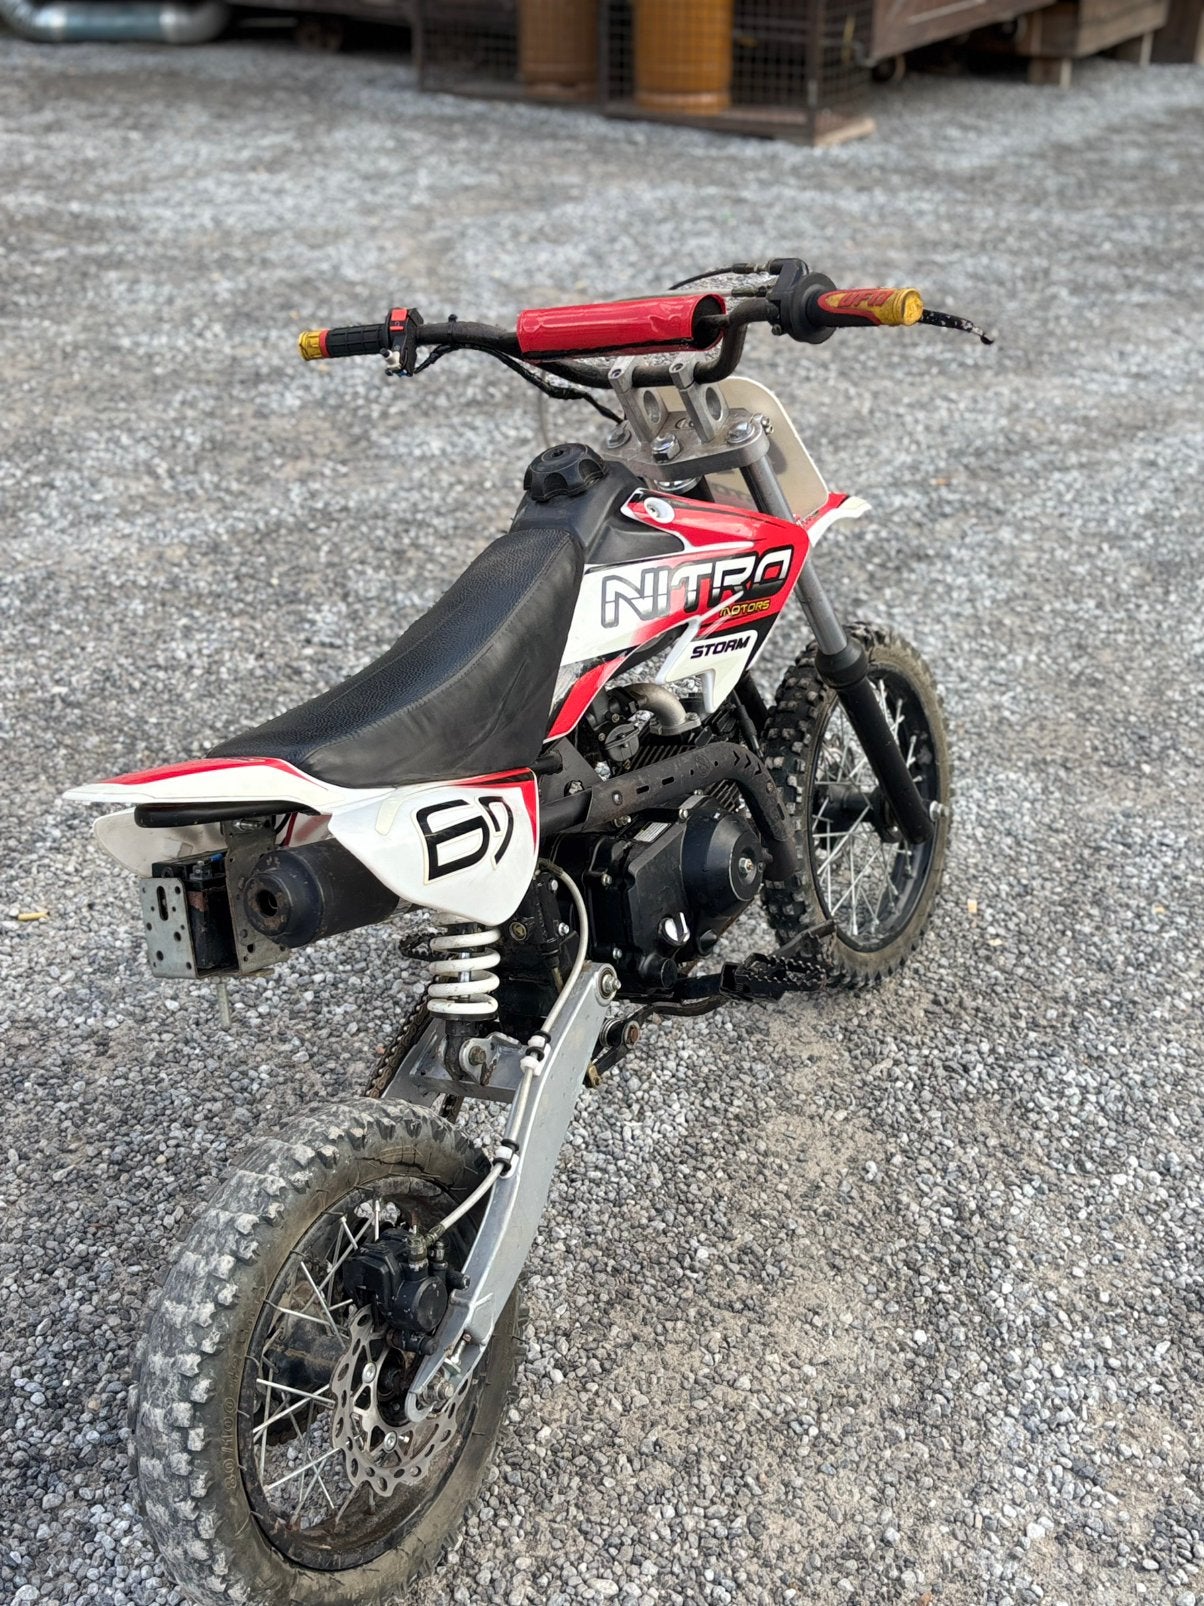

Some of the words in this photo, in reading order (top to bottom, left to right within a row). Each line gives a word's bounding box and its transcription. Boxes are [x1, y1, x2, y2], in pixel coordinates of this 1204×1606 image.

[602, 544, 795, 629] NITRO
[720, 599, 771, 616] MOTORS
[690, 635, 751, 659] STORM
